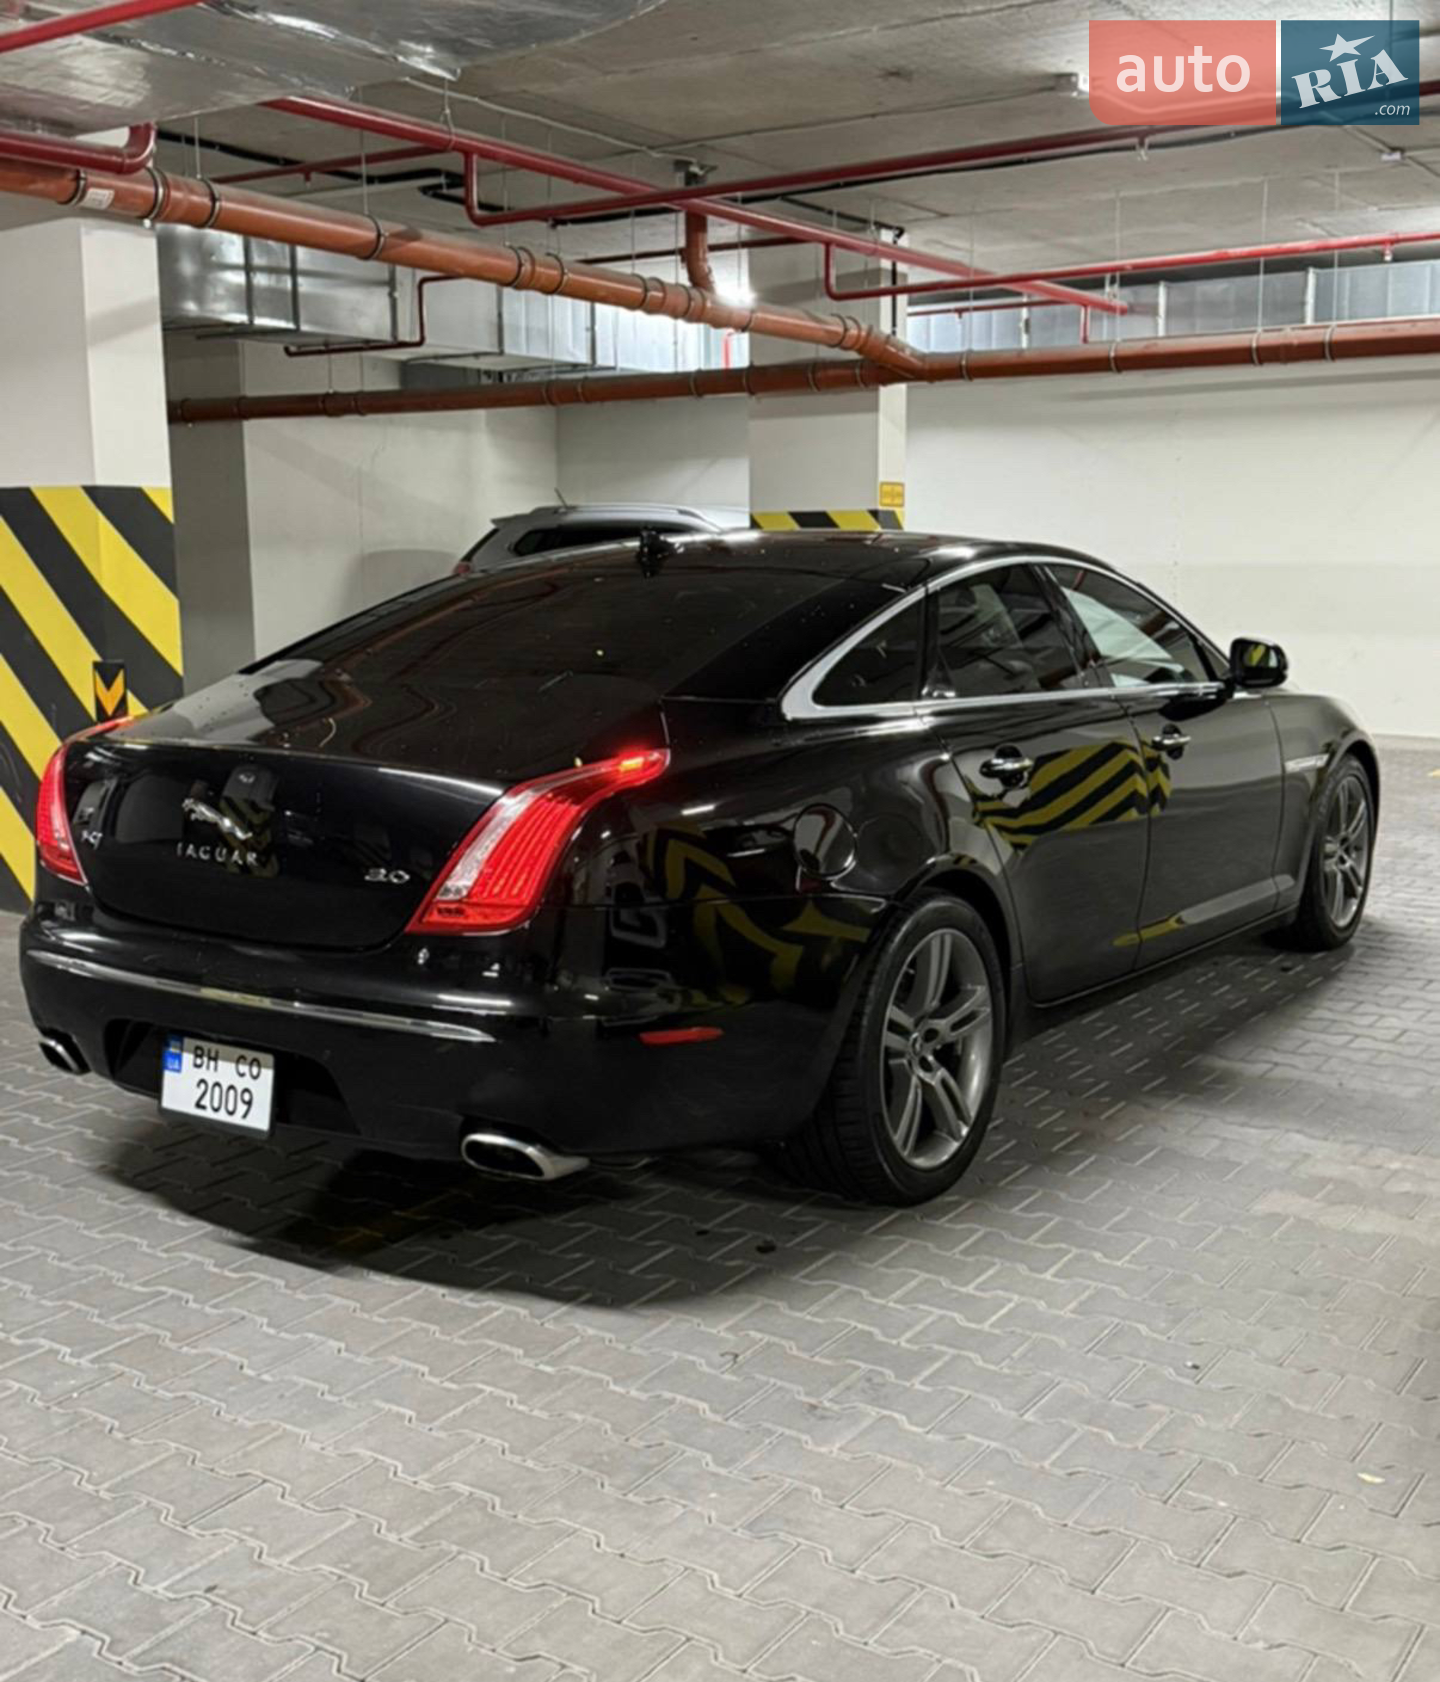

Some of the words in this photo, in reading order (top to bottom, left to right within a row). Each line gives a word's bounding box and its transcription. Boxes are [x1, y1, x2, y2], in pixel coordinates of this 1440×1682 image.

[193, 1045, 219, 1072] BH
[235, 1055, 262, 1080] CO
[194, 1078, 254, 1120] 2009
